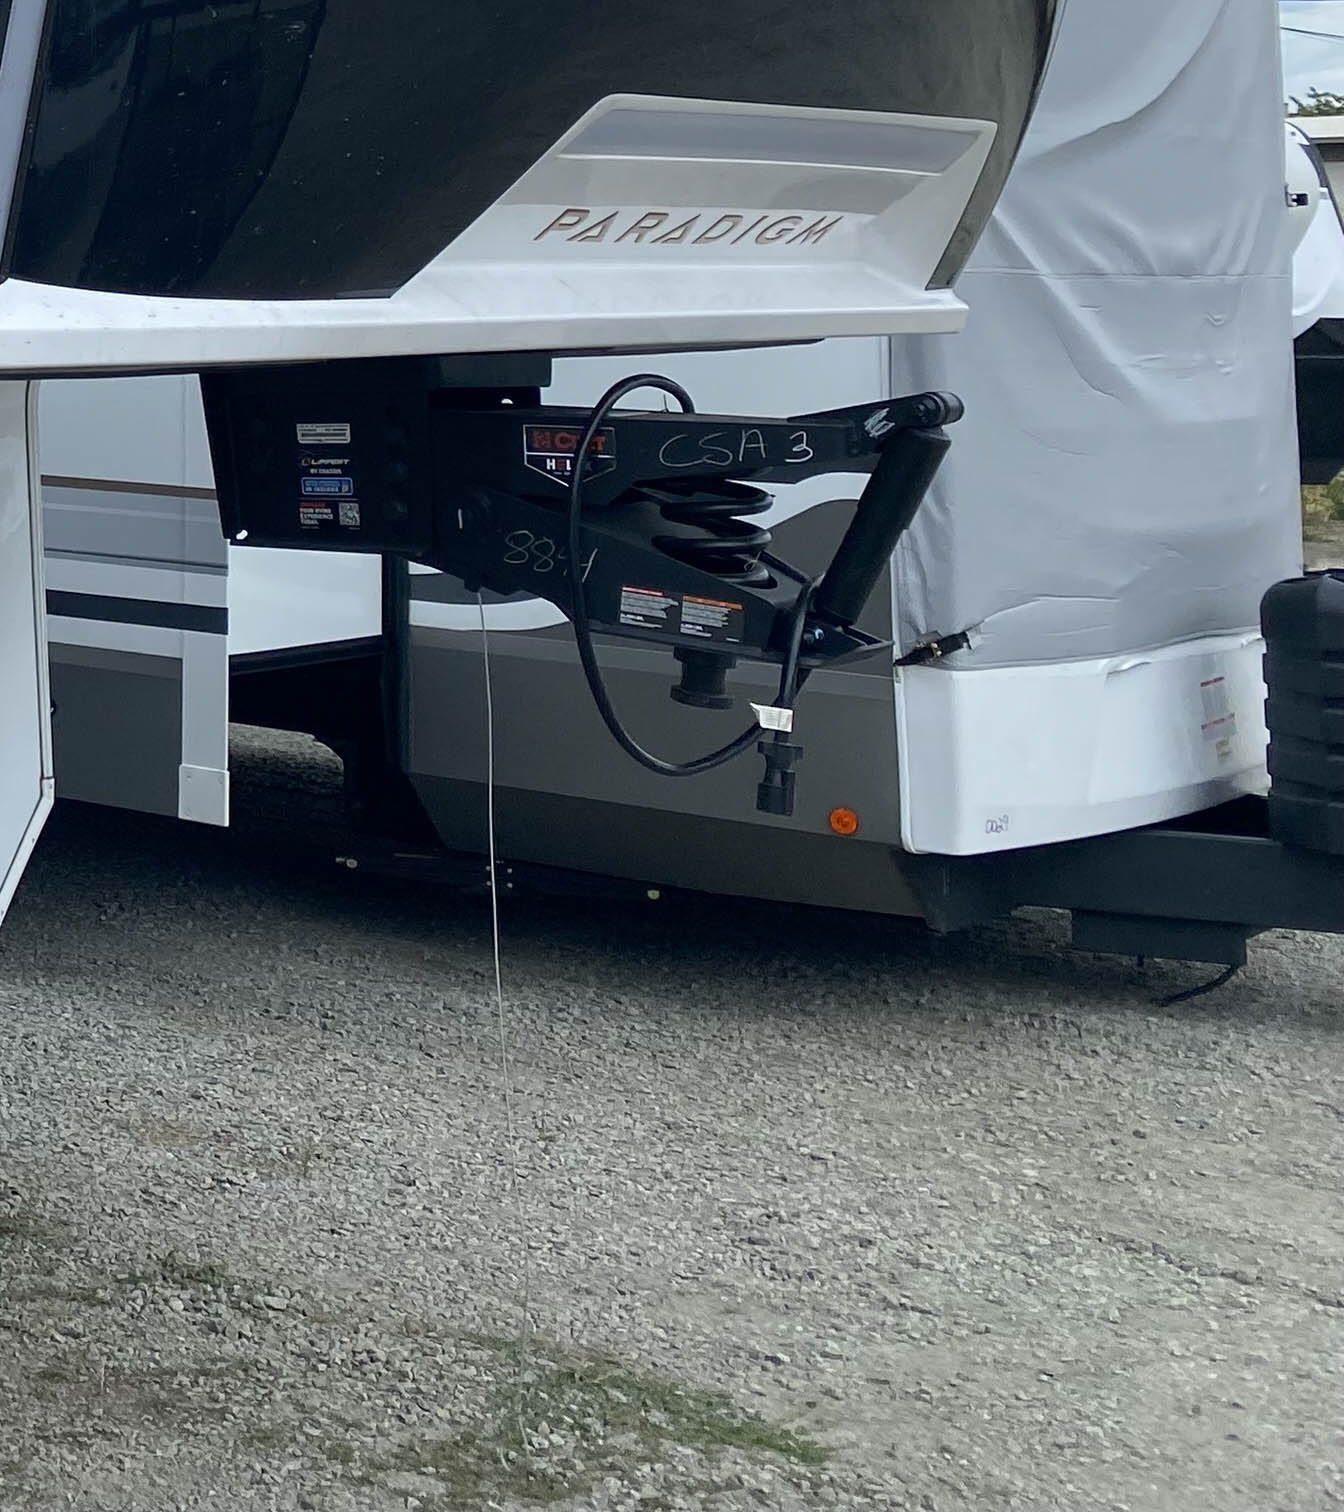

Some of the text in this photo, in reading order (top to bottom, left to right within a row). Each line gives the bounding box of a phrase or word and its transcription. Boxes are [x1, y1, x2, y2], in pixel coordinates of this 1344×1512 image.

[532, 207, 845, 246] PARADIGM
[658, 428, 814, 468] CSA 3
